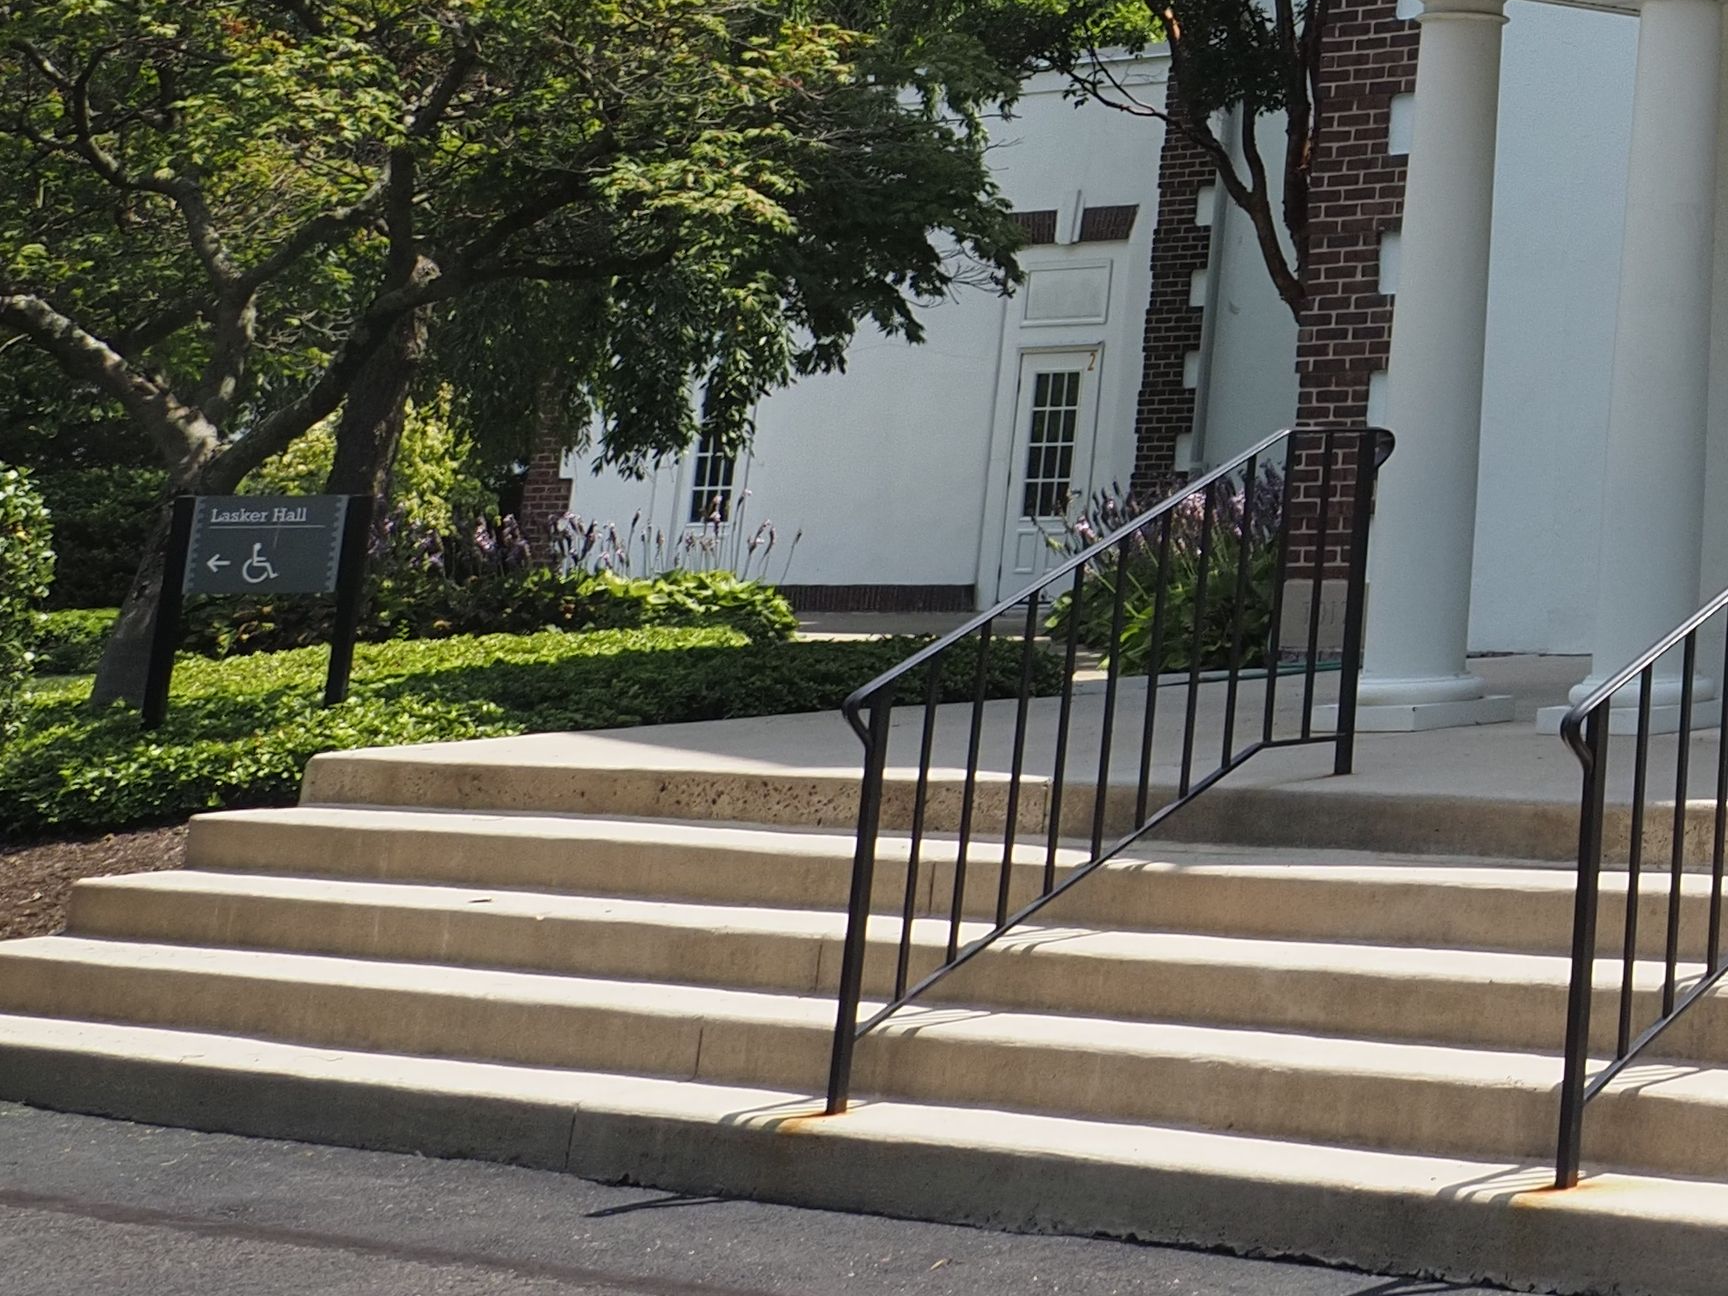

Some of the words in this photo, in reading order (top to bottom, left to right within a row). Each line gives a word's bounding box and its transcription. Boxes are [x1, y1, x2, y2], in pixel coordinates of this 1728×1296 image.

[1087, 351, 1096, 372] 2
[210, 507, 268, 523] Lasker
[272, 507, 307, 522] Hall
